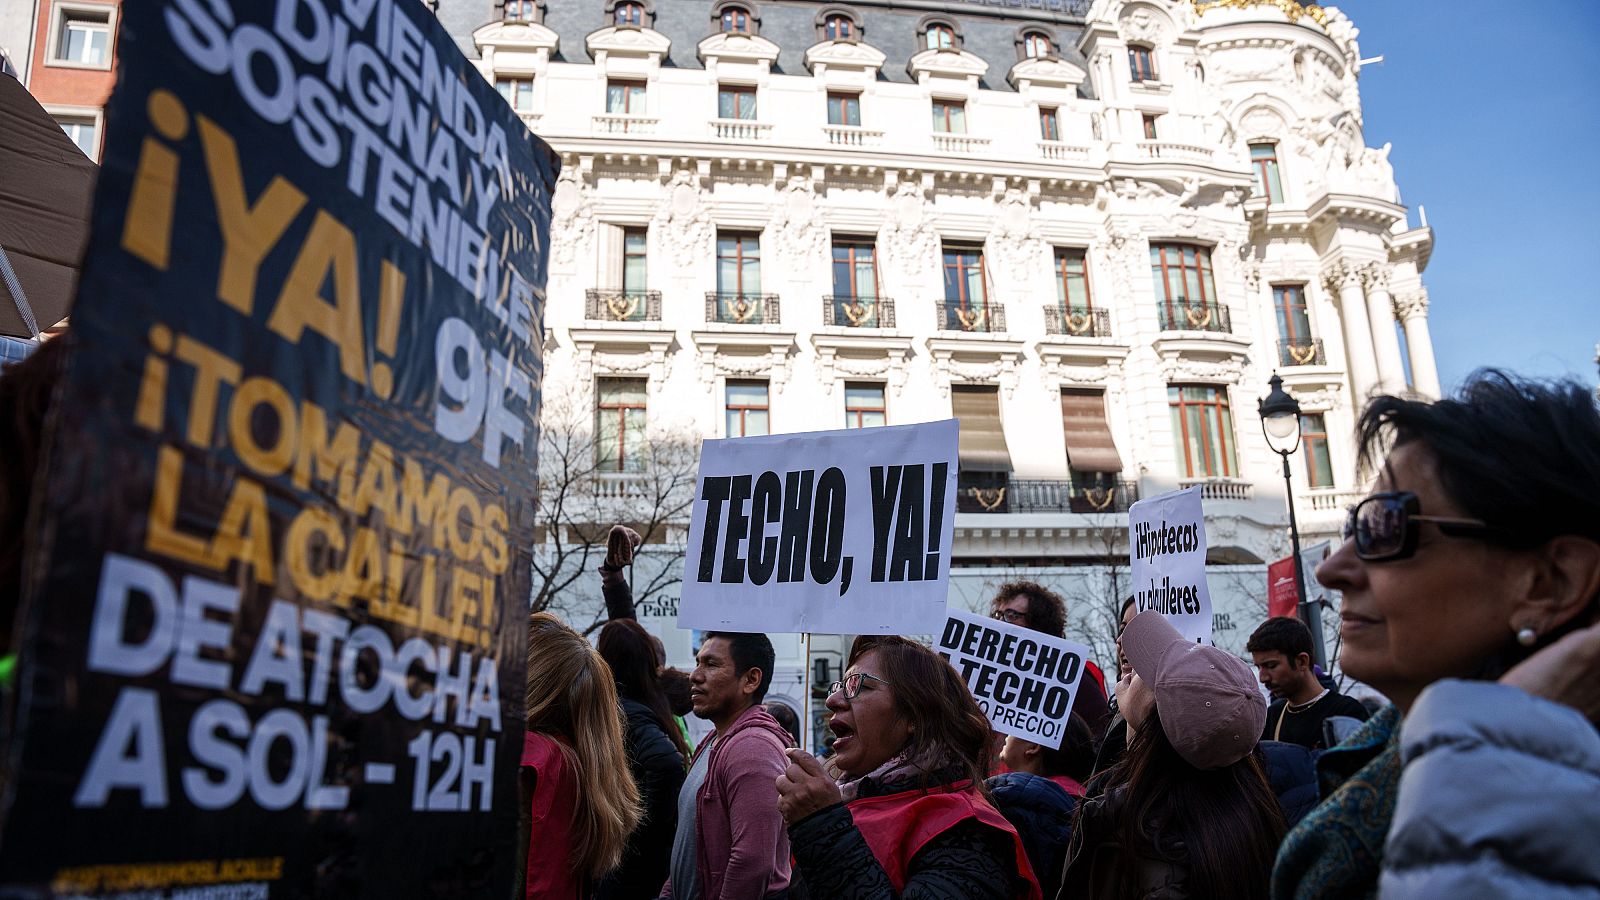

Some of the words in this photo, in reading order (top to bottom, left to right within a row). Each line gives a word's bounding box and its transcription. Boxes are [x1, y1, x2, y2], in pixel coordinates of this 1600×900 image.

[163, 0, 534, 344] SOSTENIBLE
[274, 0, 463, 206] DIGNA
[120, 88, 406, 400] ¡YA!
[134, 323, 509, 575] ¡TOMAMOS
[434, 317, 531, 468] 9F
[146, 444, 275, 585] LA
[286, 506, 496, 650] CALLE!
[697, 467, 854, 597] TECHO,
[870, 462, 949, 583] YA!
[87, 552, 242, 689] DE
[239, 600, 502, 732] ATOCHA
[939, 616, 1081, 685] DERECHO
[960, 657, 1070, 720] TECHO
[992, 704, 1062, 740] PRECIO!
[74, 687, 169, 809] A
[181, 699, 350, 811] SOL
[408, 729, 496, 812] 12H
